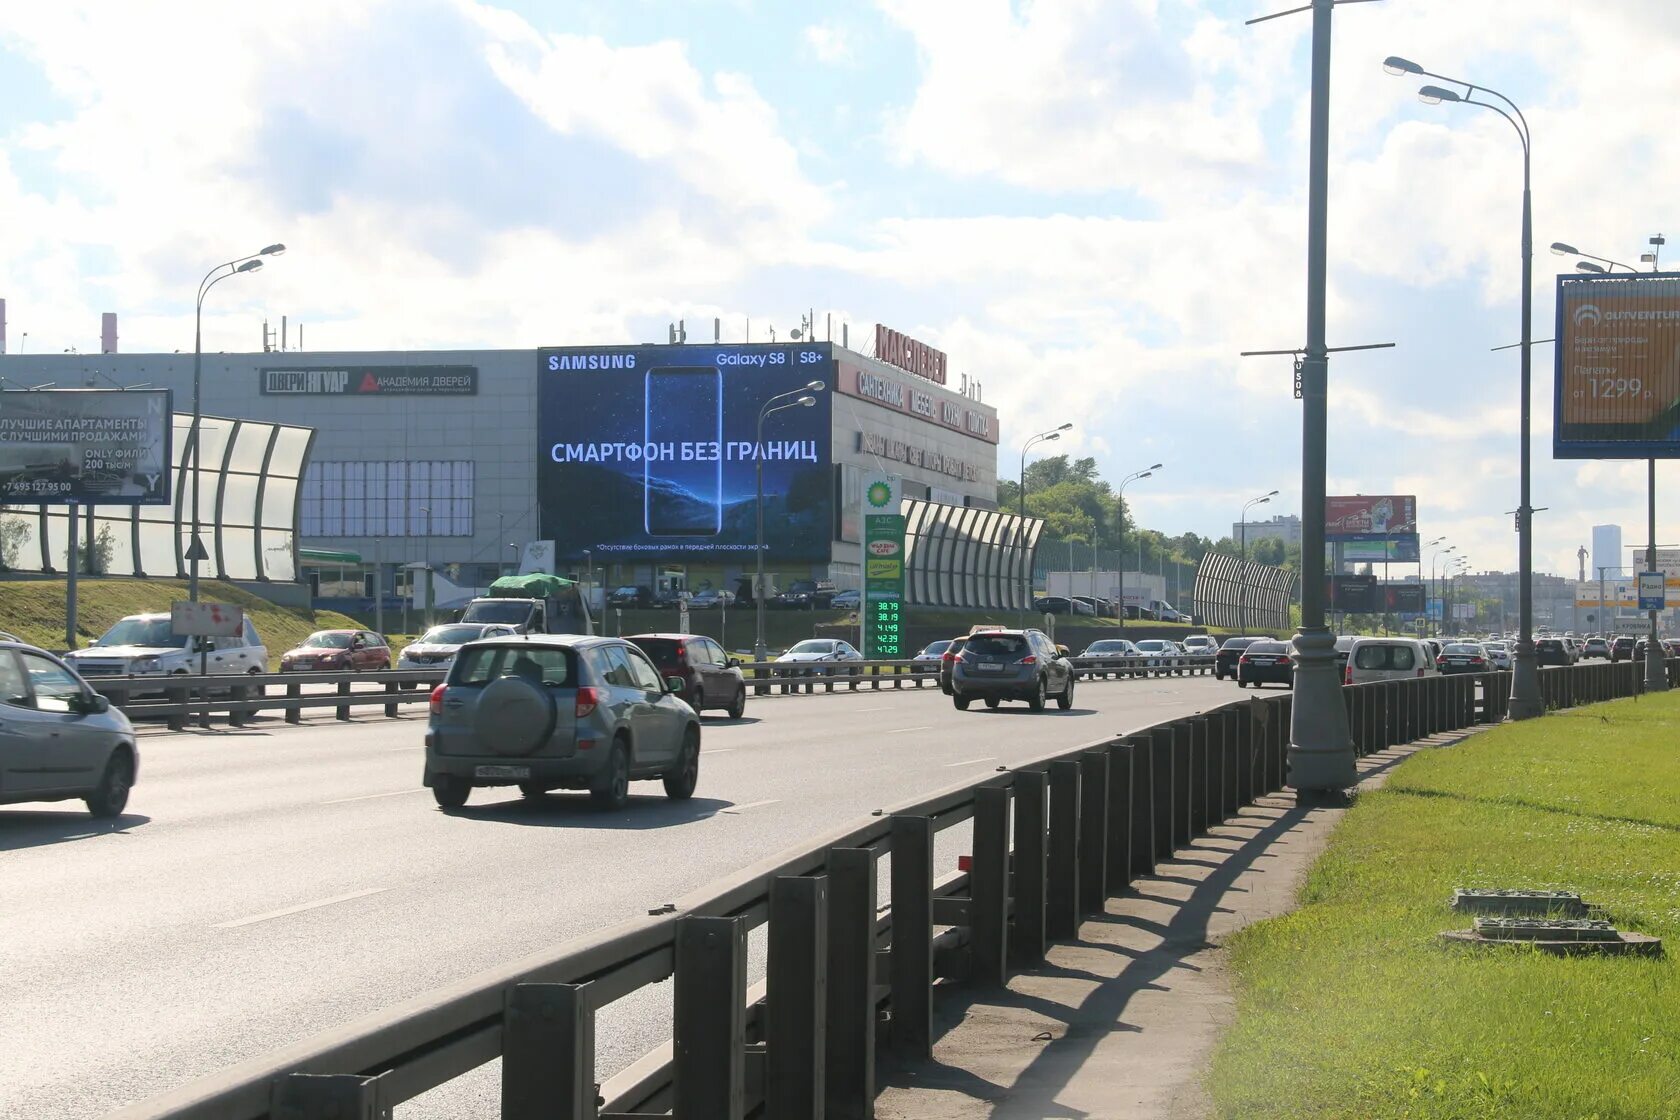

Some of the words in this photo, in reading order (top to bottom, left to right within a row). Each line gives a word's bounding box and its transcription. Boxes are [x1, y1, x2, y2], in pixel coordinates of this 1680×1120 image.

[716, 353, 766, 367] Galaxy
[769, 353, 785, 364] S8
[800, 352, 823, 363] S8+
[876, 323, 947, 385] МАКСЛЕВЕЛ
[549, 354, 636, 370] SAMSUNG
[269, 373, 304, 390] ДВЕРИ
[308, 371, 349, 393] ЯГУАР
[376, 376, 429, 385] АКАДЕМИЯ
[432, 375, 471, 386] ДВЕРЕЙ
[1573, 390, 1585, 398] от
[1589, 378, 1642, 398] 1299
[858, 371, 904, 408] САНТЕХНИКА
[910, 389, 936, 418] МЕБЕЛЬ
[0, 419, 52, 430] ЛУЧШИЕ
[55, 419, 147, 430] АПАРТАМЕНТЫ
[0, 432, 7, 441] С
[9, 432, 69, 441] ЛУЧШИМИ
[72, 432, 147, 442] ПРОДАЖАМИ
[85, 450, 113, 458] ONLY
[115, 449, 146, 458] ФИЛИ
[551, 442, 674, 463] СМАРТФОН
[681, 442, 721, 461] БЕЗ
[727, 441, 817, 462] ГРАНИЦ
[85, 460, 103, 469] 200
[2, 483, 11, 491] +7
[14, 483, 31, 491] 495
[32, 483, 47, 491] 127
[48, 483, 59, 491] 95
[60, 483, 71, 491] 00
[878, 602, 898, 610] 38.79
[878, 613, 898, 621] 38.19
[878, 624, 898, 632] 41.49
[878, 635, 898, 643] 42.39
[878, 646, 898, 654] 47.29
